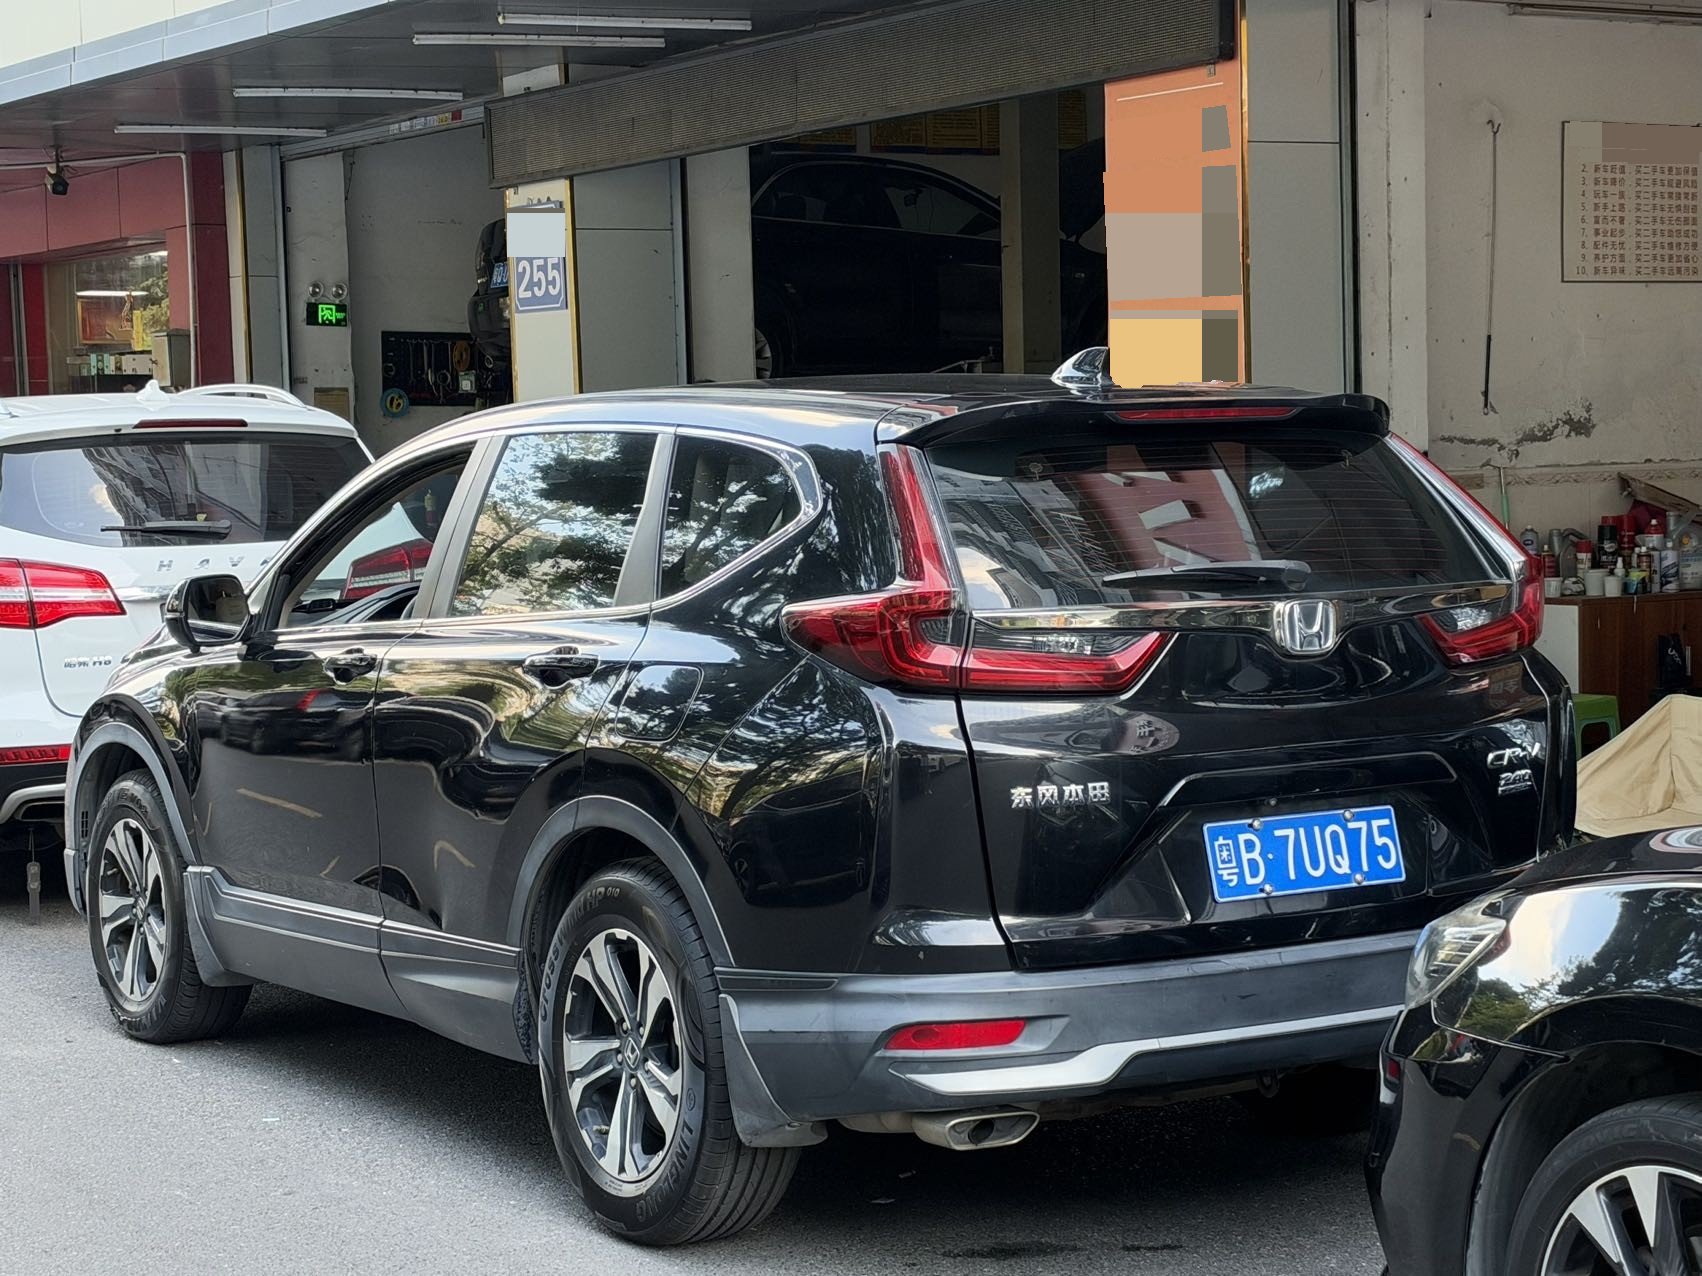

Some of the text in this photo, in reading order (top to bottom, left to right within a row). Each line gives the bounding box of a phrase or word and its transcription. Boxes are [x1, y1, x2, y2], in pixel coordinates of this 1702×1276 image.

[518, 257, 561, 299] 255
[157, 556, 273, 572] HAVA
[1010, 781, 1111, 809] 东风本田
[636, 1118, 695, 1223] LINGLONG
